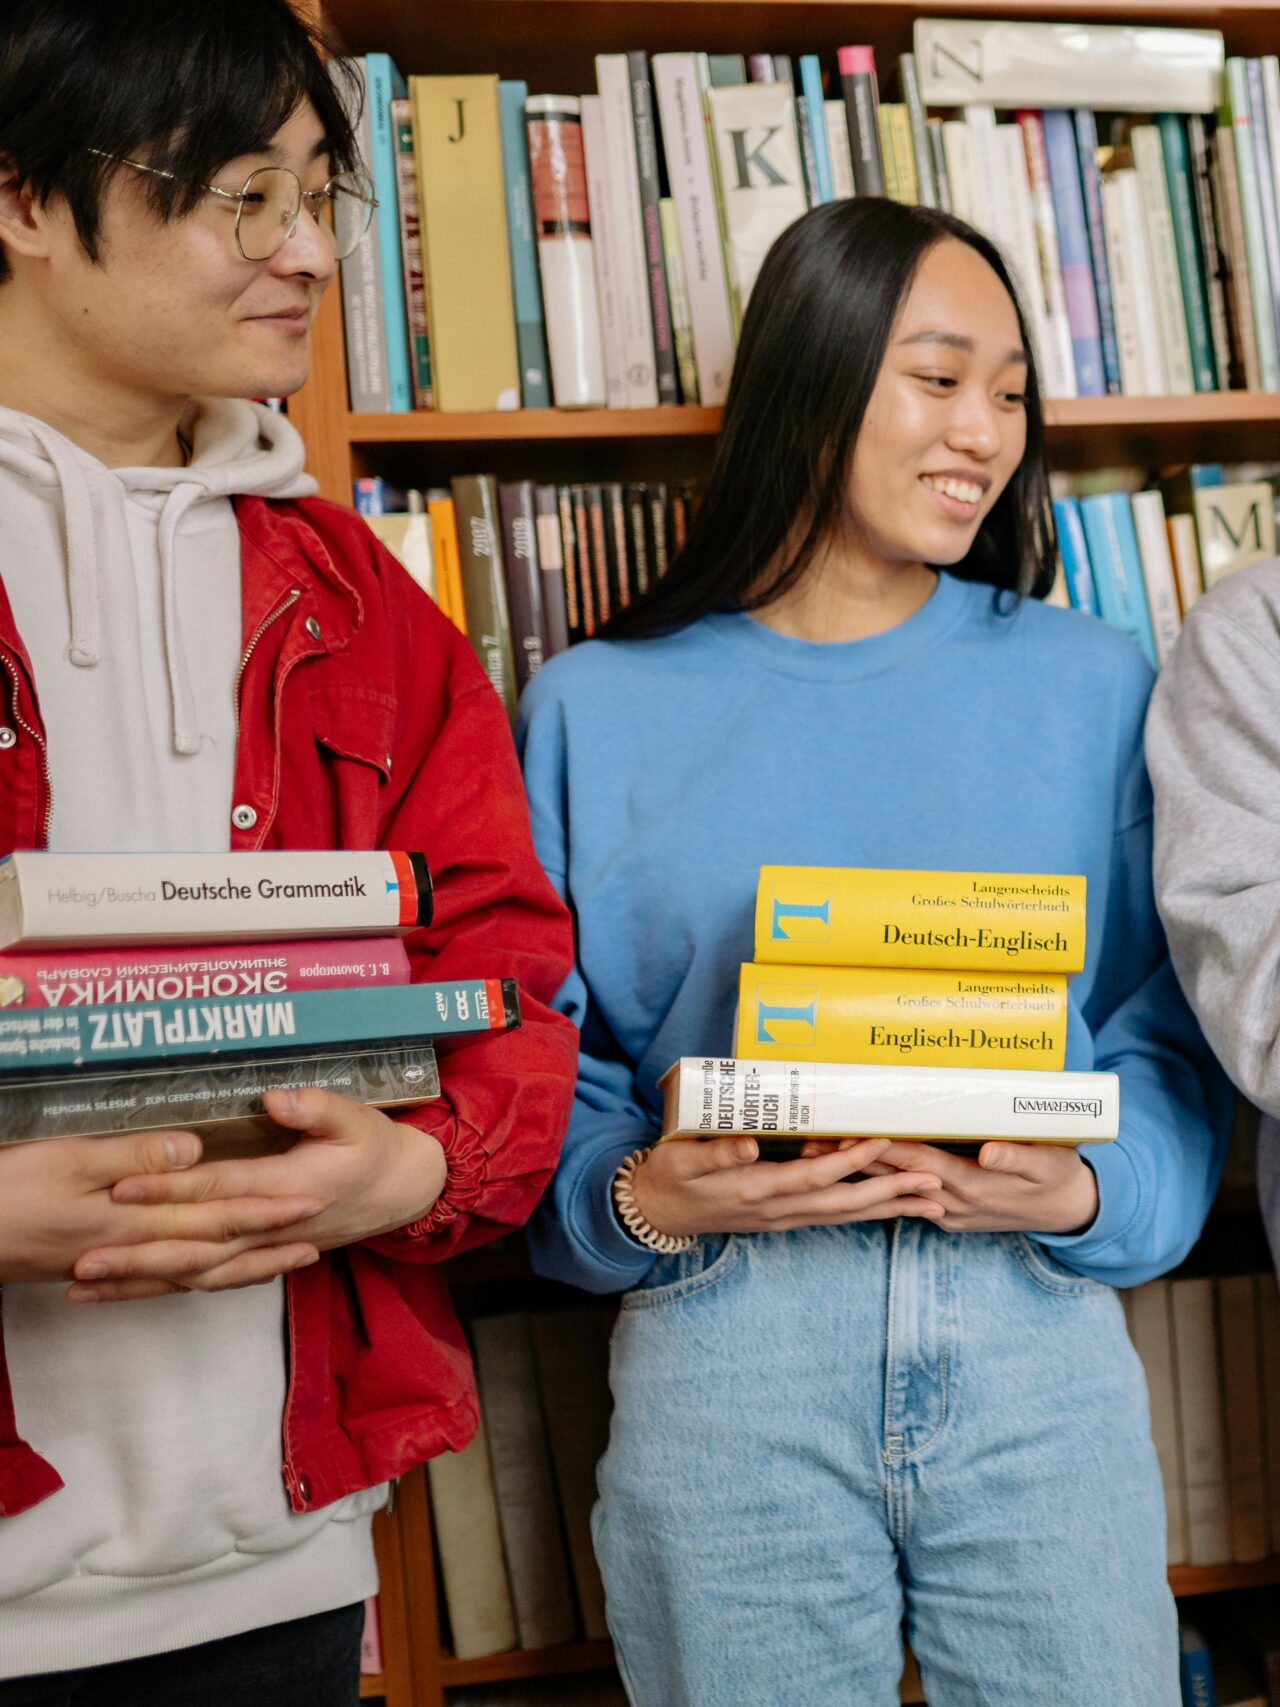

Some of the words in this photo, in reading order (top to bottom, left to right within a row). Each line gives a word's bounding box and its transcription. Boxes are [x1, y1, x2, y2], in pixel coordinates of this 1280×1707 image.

[447, 98, 469, 144] J
[729, 125, 791, 189] K
[1208, 502, 1264, 551] M
[48, 885, 157, 907] Helbig/Buscha
[160, 877, 252, 901] Deutsche
[257, 875, 367, 899] Grammatik
[911, 894, 957, 907] Großes
[960, 896, 1070, 913] Schulwörterbuch
[972, 881, 1070, 896] Langenscheidts
[883, 924, 1068, 957] Deutsch-Englisch
[36, 967, 112, 980] СЛОВАРЬ
[299, 963, 366, 977] Золотогоров
[38, 970, 288, 1007] ЭКОНОМИКА
[896, 995, 942, 1007] Großes
[945, 997, 1055, 1011] Schulwörterbuch
[958, 981, 1055, 995] Langenscheidts
[454, 990, 470, 1020] CDC
[88, 1001, 296, 1050] MARKTPLATZ
[870, 1026, 1054, 1054] Englisch-Deutsch
[43, 1103, 92, 1116] MEMORIA
[94, 1098, 136, 1111] SILESIAE
[145, 1095, 166, 1106] ZUM
[168, 1090, 215, 1104] GEDENKEN
[217, 1089, 231, 1098] AN
[233, 1086, 266, 1097] MARIAN
[702, 1087, 714, 1110] neue
[717, 1060, 736, 1130] DEUTSCHE
[739, 1067, 760, 1131] WÖRTER-
[699, 1112, 712, 1129] Das
[761, 1094, 779, 1131] BUCH
[801, 1105, 810, 1124] BUCH
